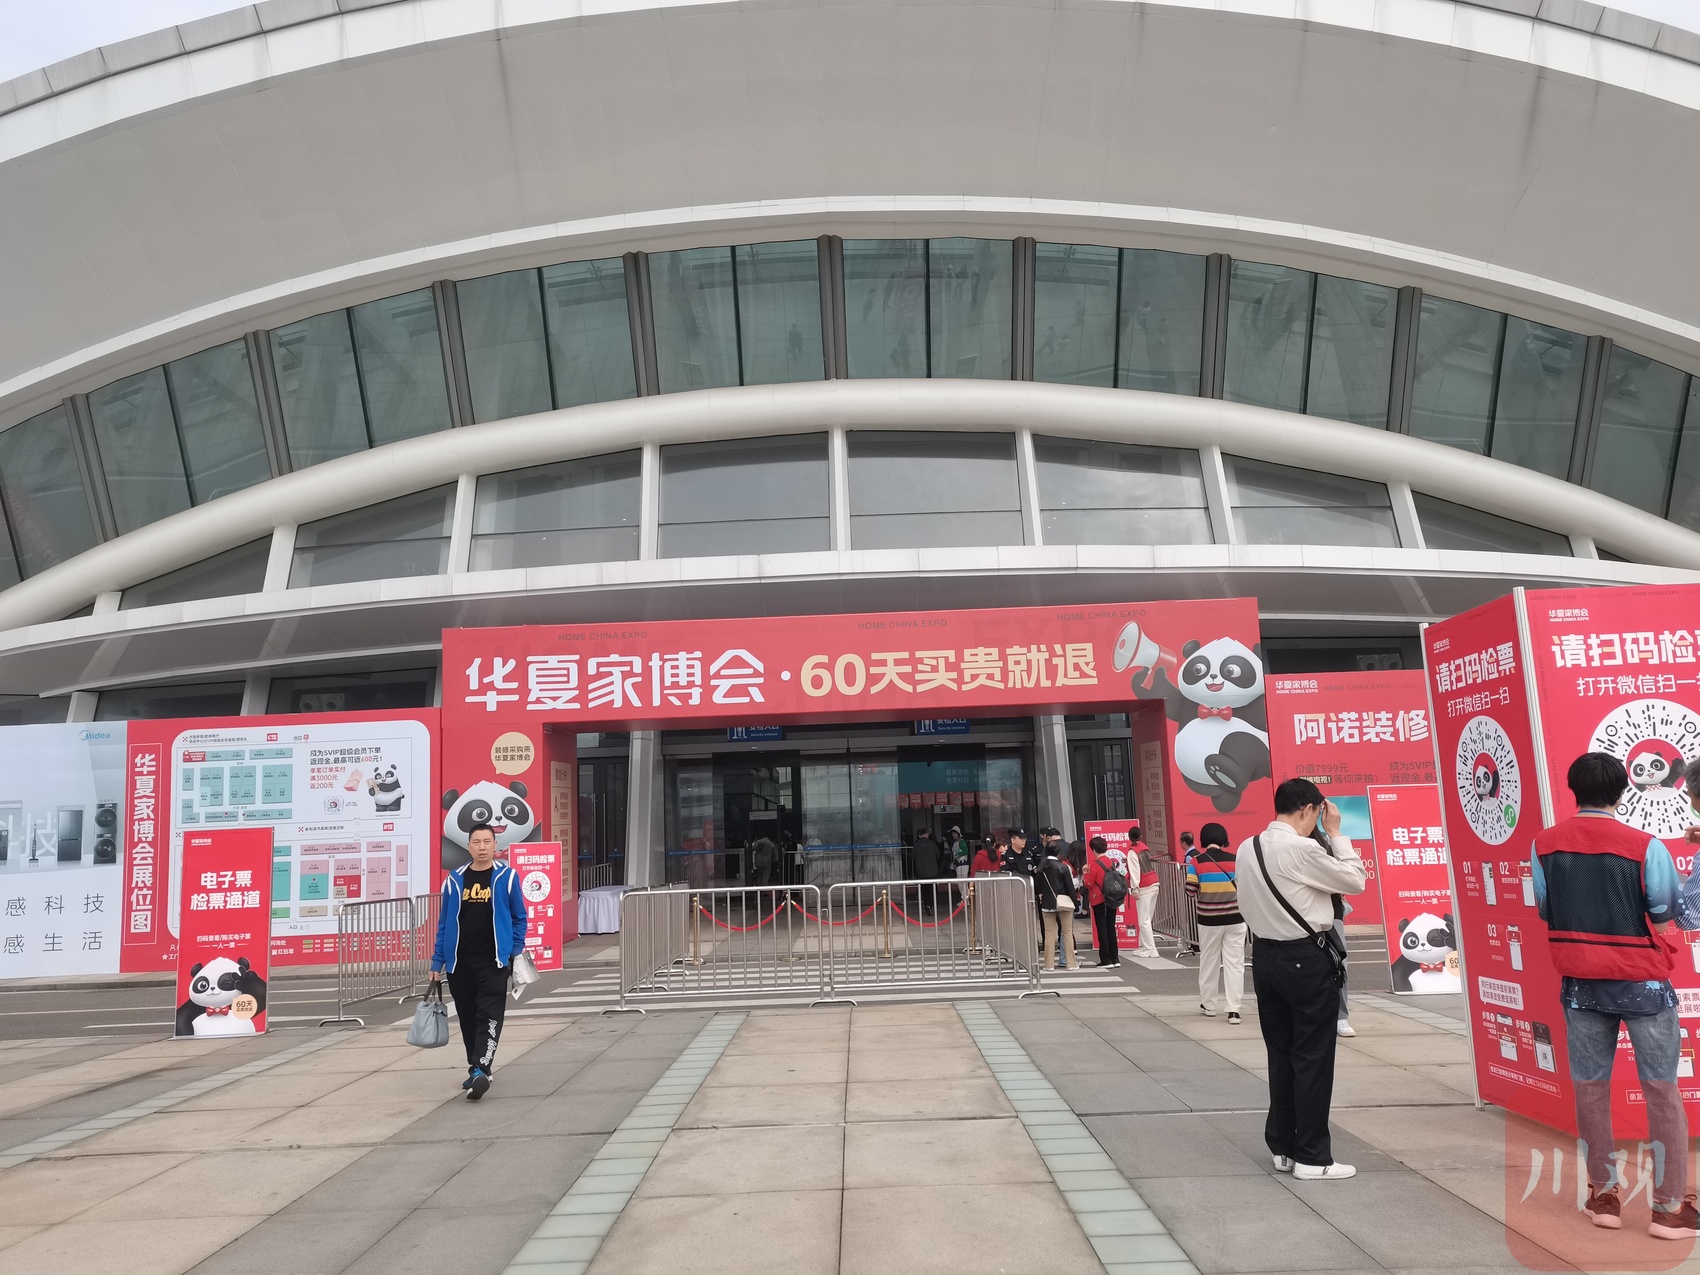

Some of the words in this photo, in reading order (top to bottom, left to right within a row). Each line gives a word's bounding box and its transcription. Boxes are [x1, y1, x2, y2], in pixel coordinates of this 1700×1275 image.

[1056, 611, 1086, 621] HOME
[1088, 610, 1116, 619] CHINA
[1118, 609, 1147, 617] EXPO
[1548, 608, 1589, 617] 华夏家博会
[858, 620, 887, 630] HOME
[890, 619, 917, 629] CHINA
[919, 618, 948, 627] EXPO
[558, 632, 587, 641] HOME
[589, 631, 619, 640] CHINA
[621, 631, 648, 639] EXPO
[1436, 641, 1516, 694] 请扫码检票
[1275, 679, 1319, 690] 华夏家博会
[1447, 686, 1510, 718] 打开微信扫一扫
[1293, 709, 1429, 745] 阿诺装修
[79, 729, 111, 741] Midea
[310, 747, 381, 757] 成为SVIP超级会员下单
[495, 745, 531, 754] 装修采购来
[494, 753, 531, 762] 华夏家博会
[310, 766, 346, 774] 单笔订单实付
[1295, 763, 1349, 774] 价值7999元
[310, 774, 338, 782] 满3000元
[1390, 772, 1438, 783] 返现金,最
[310, 782, 335, 790] 返200元
[1392, 826, 1444, 845] 电子票
[130, 753, 156, 933] 华夏家博会展位图
[1463, 861, 1472, 874] 01
[1499, 861, 1510, 875] 02
[200, 870, 252, 889] 电子票
[190, 890, 260, 911] 检票通道
[1487, 923, 1497, 937] 03
[196, 933, 252, 942] 扫码查看/购买电子票
[236, 1000, 253, 1009] 60天
